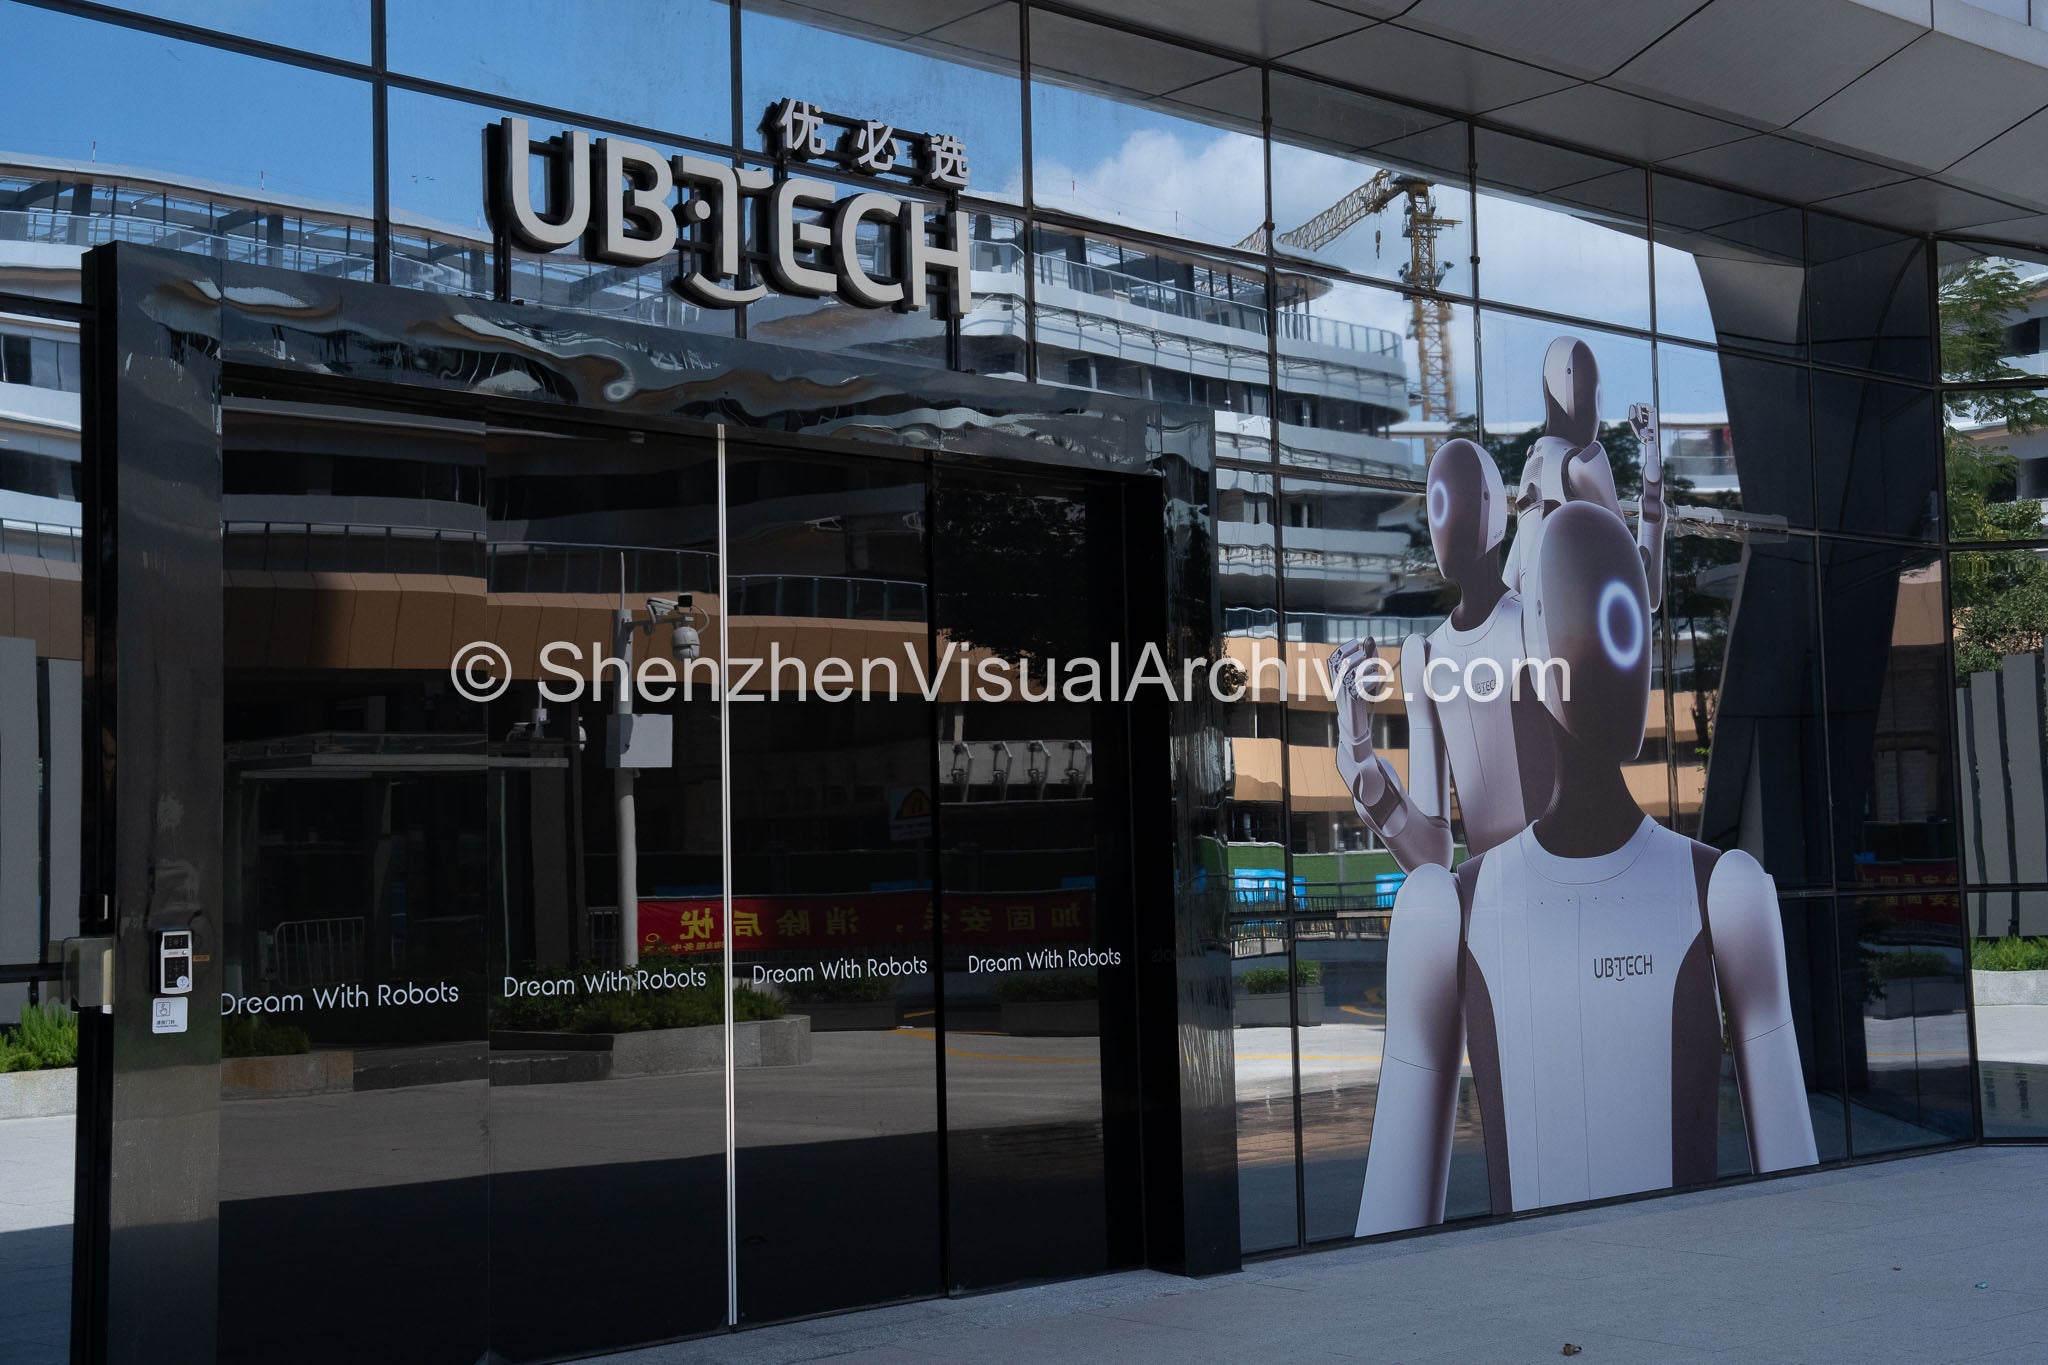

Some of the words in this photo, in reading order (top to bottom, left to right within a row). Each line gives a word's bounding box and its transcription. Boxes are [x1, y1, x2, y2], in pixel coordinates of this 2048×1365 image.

[779, 98, 971, 189] 优必选
[501, 116, 973, 315] UBTECH
[752, 965, 815, 985] Dream
[820, 957, 862, 980] With
[867, 955, 928, 978] Robots
[968, 955, 1022, 974] Dream
[1027, 948, 1064, 970] With
[1068, 947, 1122, 967] Robots
[1593, 954, 1653, 982] UBTECH
[503, 976, 575, 998] Dream
[582, 970, 630, 994] With
[637, 967, 707, 991] Robots
[220, 992, 304, 1016] Dream
[312, 983, 369, 1010] With
[377, 981, 461, 1007] Robots
